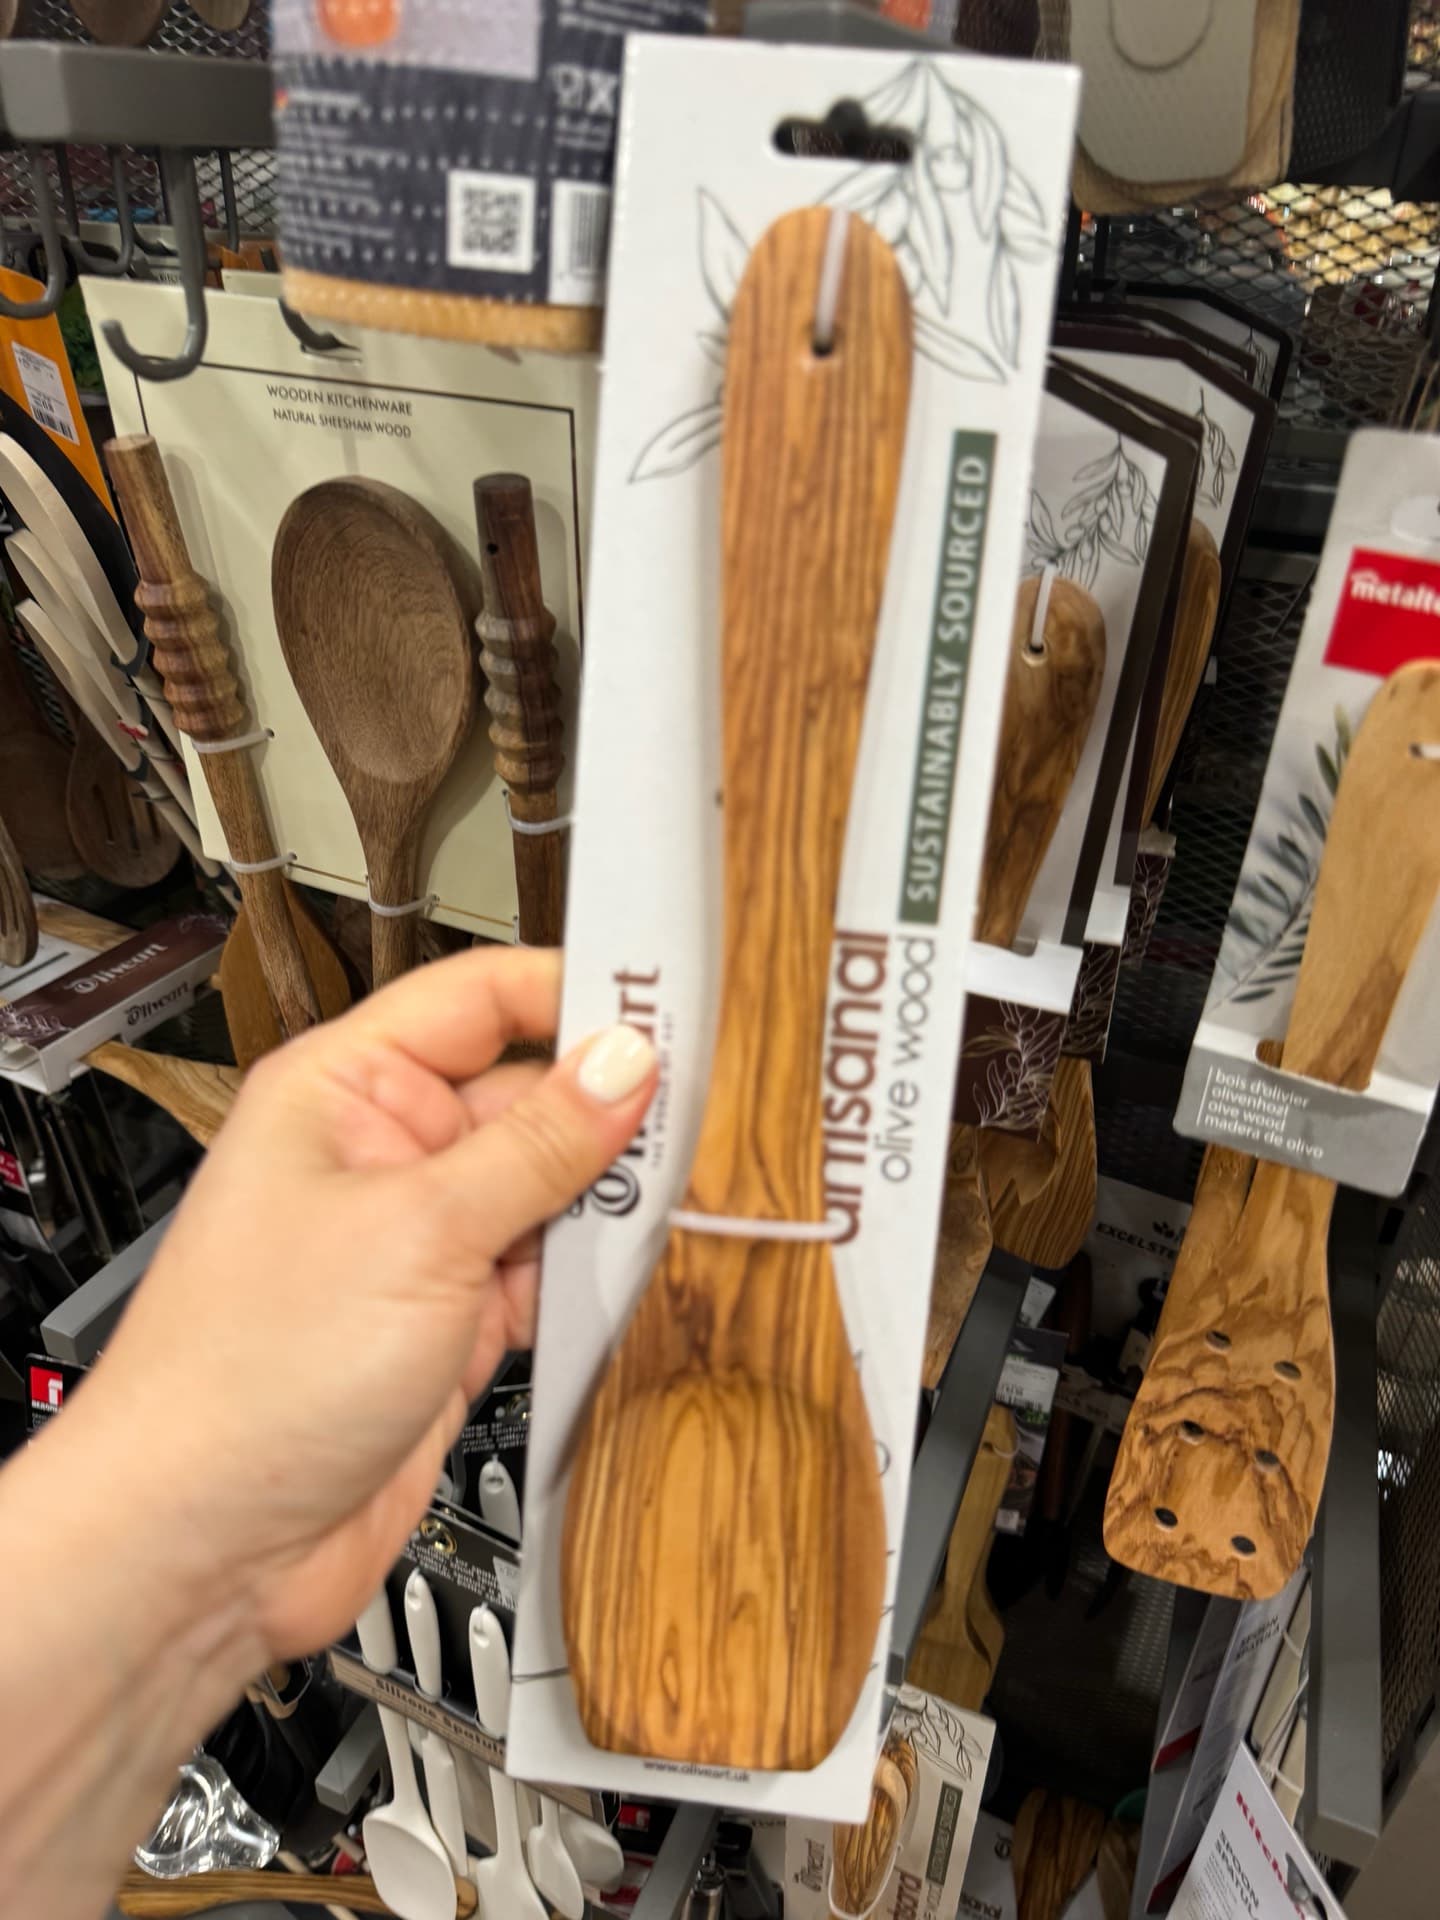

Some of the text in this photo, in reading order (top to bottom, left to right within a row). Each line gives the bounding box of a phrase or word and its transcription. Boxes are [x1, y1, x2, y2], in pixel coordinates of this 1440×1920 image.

[267, 384, 412, 416] WOODEN KITCHENWARE
[273, 408, 411, 439] NATURAL SHEESHAM WOOD
[906, 456, 988, 904] SUSTAINABLY SOURCED
[873, 934, 936, 1184] olive wood
[1215, 1068, 1311, 1109] bois d'olivier
[1204, 1114, 1324, 1159] madera de olivo
[1243, 1108, 1287, 1133] wood
